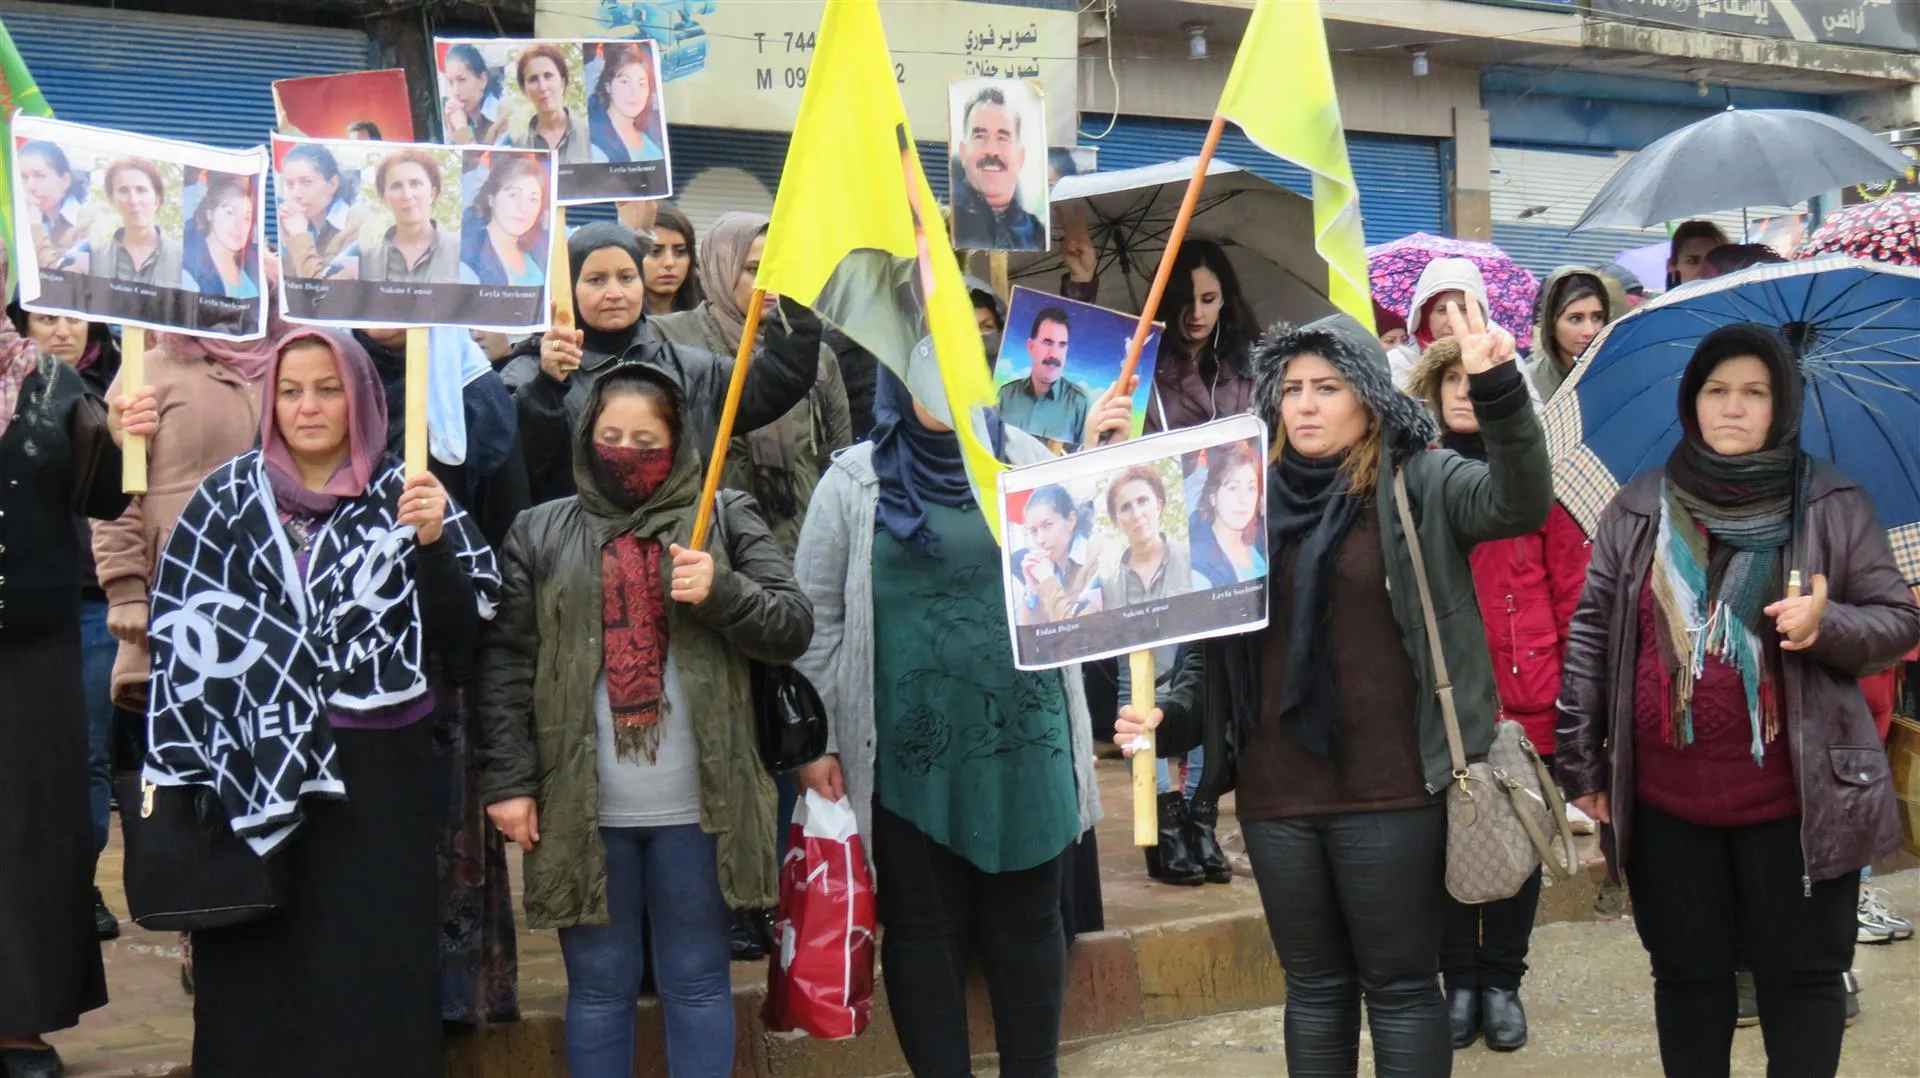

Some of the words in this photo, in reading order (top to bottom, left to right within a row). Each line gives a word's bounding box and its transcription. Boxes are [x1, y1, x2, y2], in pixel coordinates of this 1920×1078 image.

[1822, 6, 1865, 37] أراضي
[754, 32, 766, 54] T
[965, 24, 995, 55] فوري
[998, 23, 1037, 51] تصوير
[756, 68, 772, 89] M
[211, 700, 312, 757] ANEL
